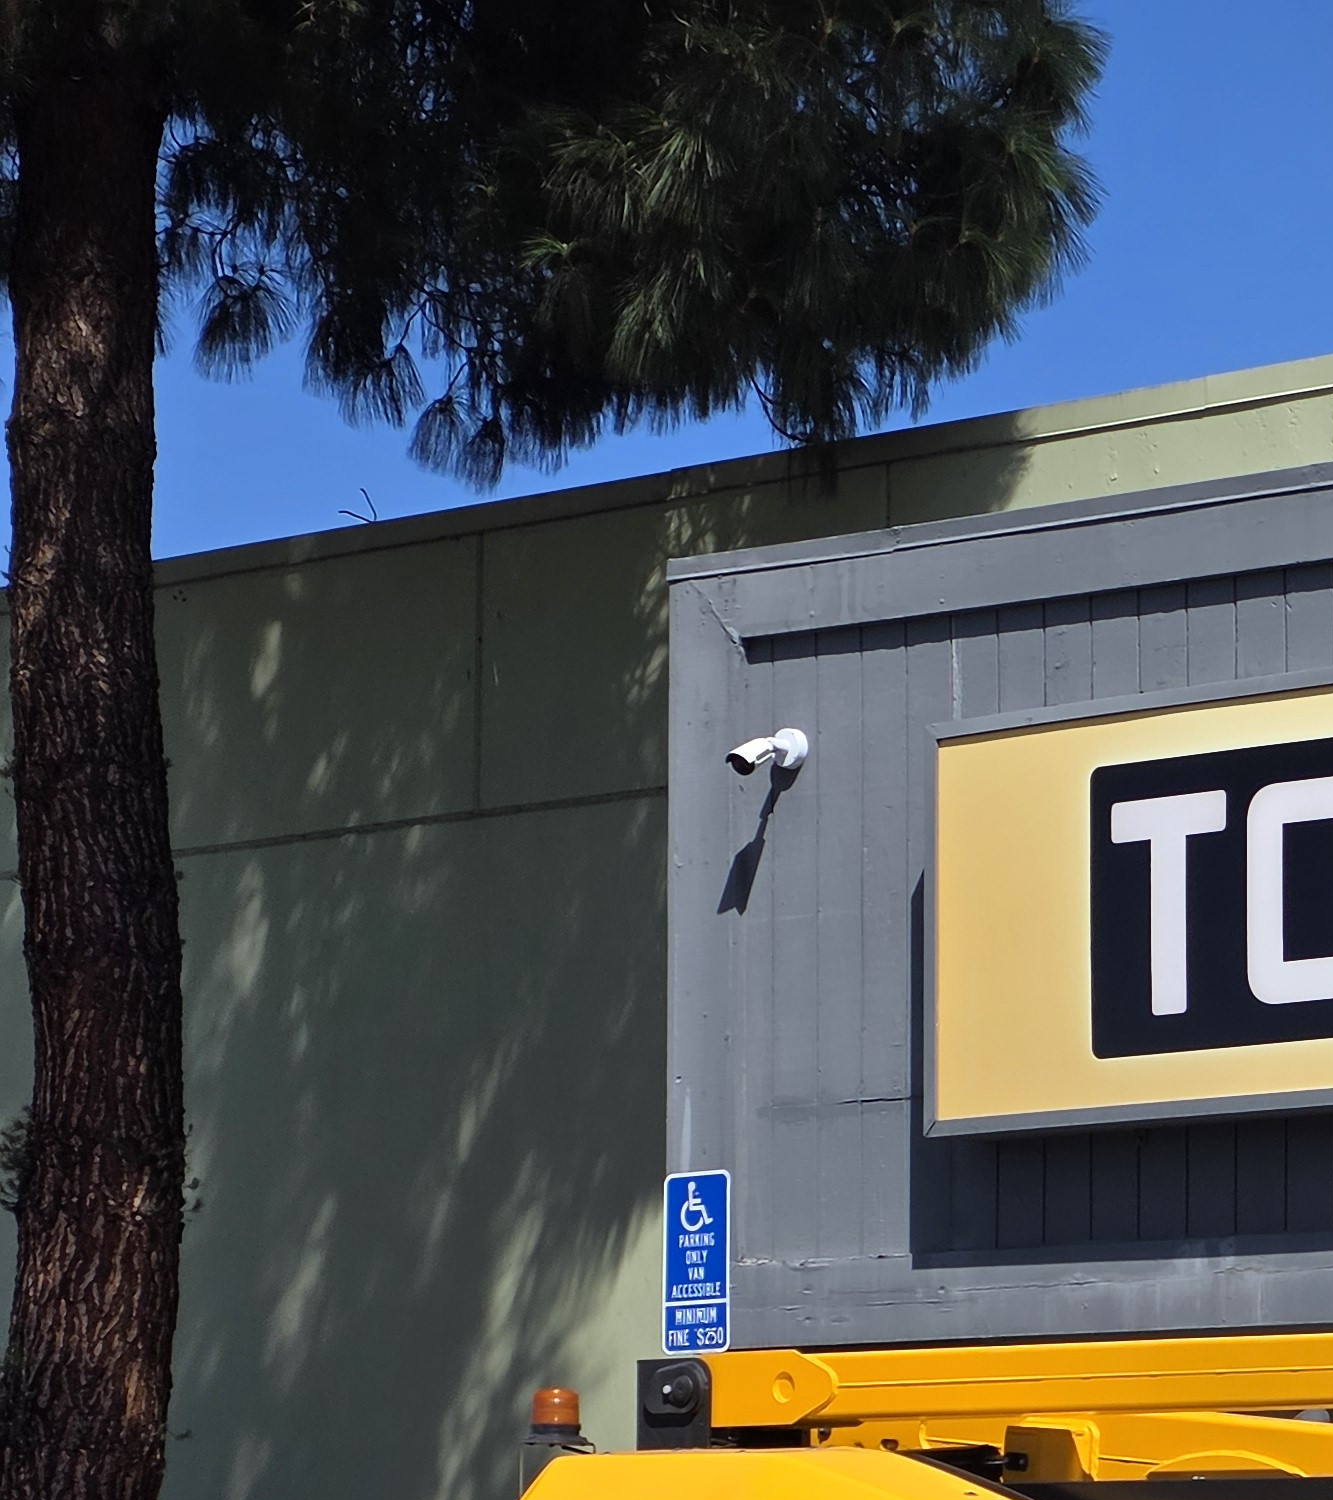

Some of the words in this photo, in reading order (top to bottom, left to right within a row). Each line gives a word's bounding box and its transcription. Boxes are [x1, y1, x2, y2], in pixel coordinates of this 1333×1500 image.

[678, 1232, 715, 1248] PARKING
[685, 1250, 708, 1265] ONLY
[688, 1266, 705, 1281] VAN
[671, 1282, 721, 1299] ACCESSIBLE
[675, 1307, 717, 1326] MINIMUM
[668, 1329, 690, 1348] FINE
